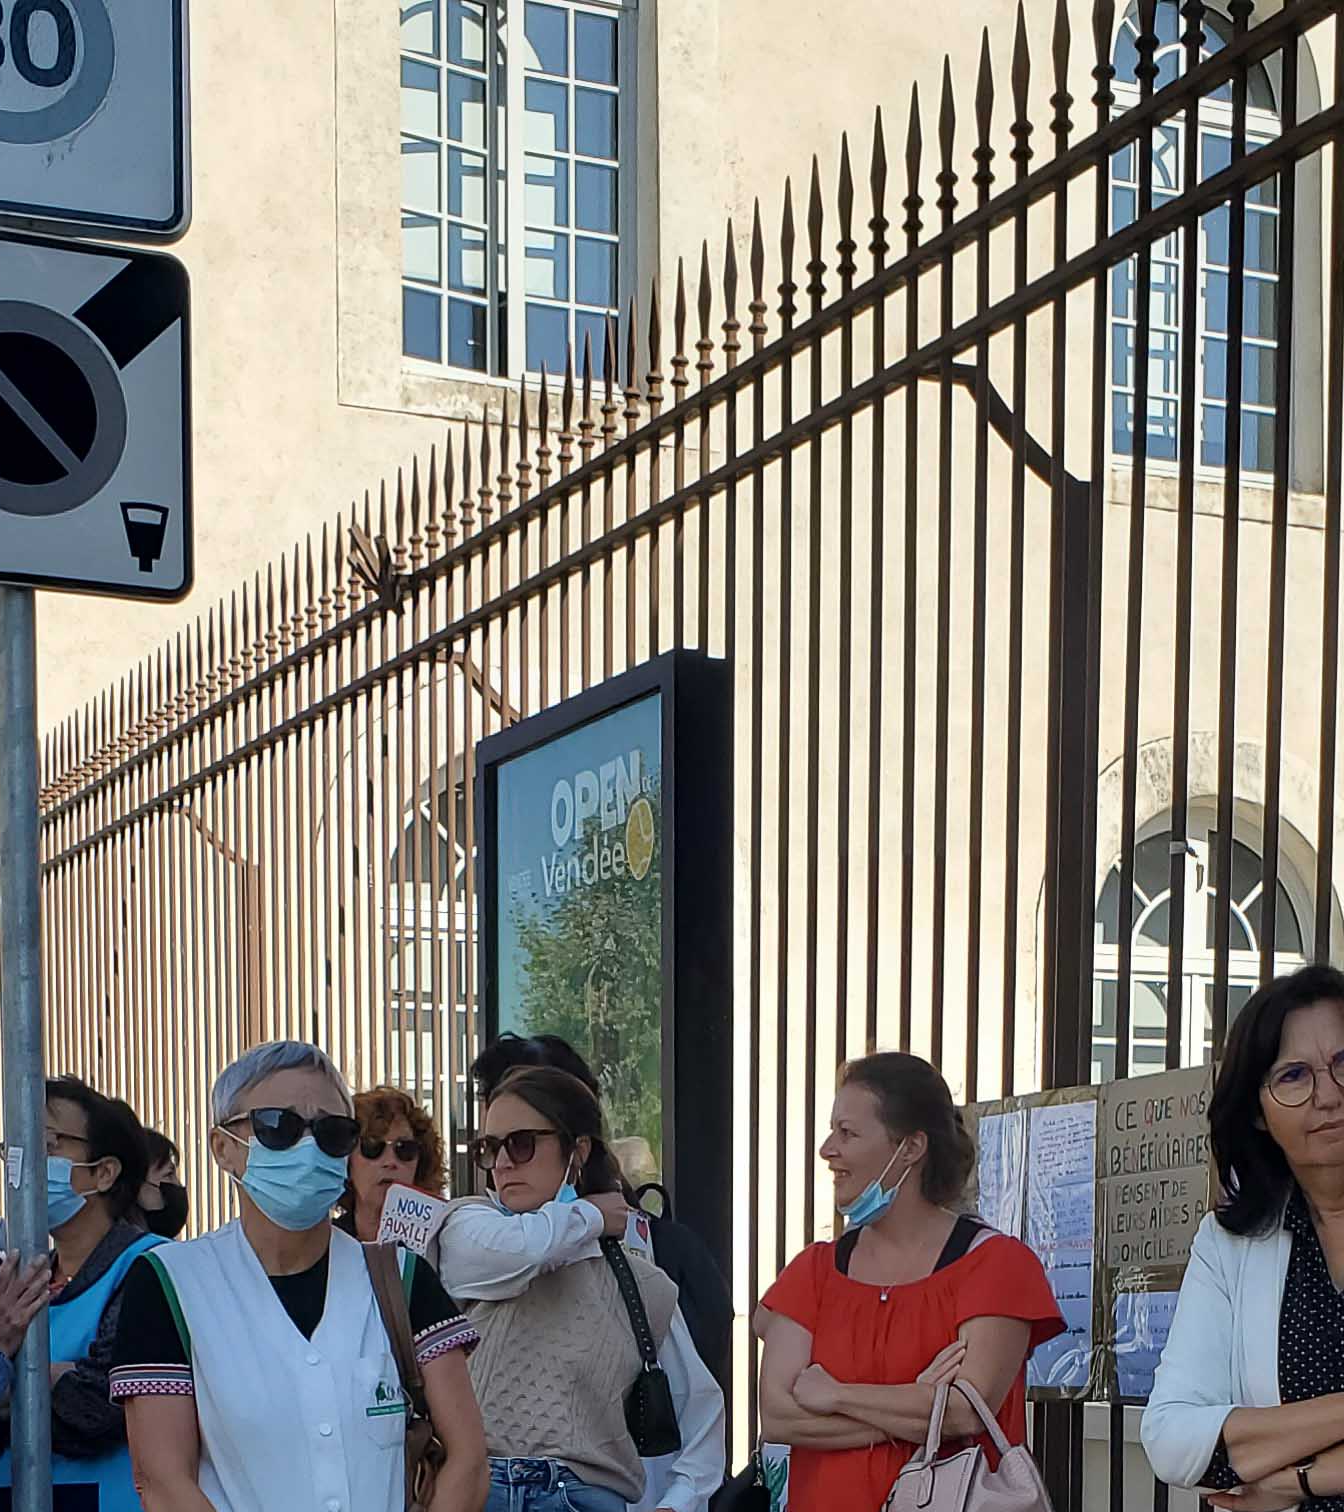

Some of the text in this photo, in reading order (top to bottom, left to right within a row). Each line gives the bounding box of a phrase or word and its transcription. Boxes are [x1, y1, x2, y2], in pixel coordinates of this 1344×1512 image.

[551, 750, 642, 847] OPEN
[541, 832, 626, 897] Vendée
[1114, 1089, 1206, 1132] CE QUE NOS
[397, 1197, 433, 1221] NOUS
[1115, 1179, 1189, 1206] PENSENT DE
[1111, 1210, 1147, 1235] LEURS
